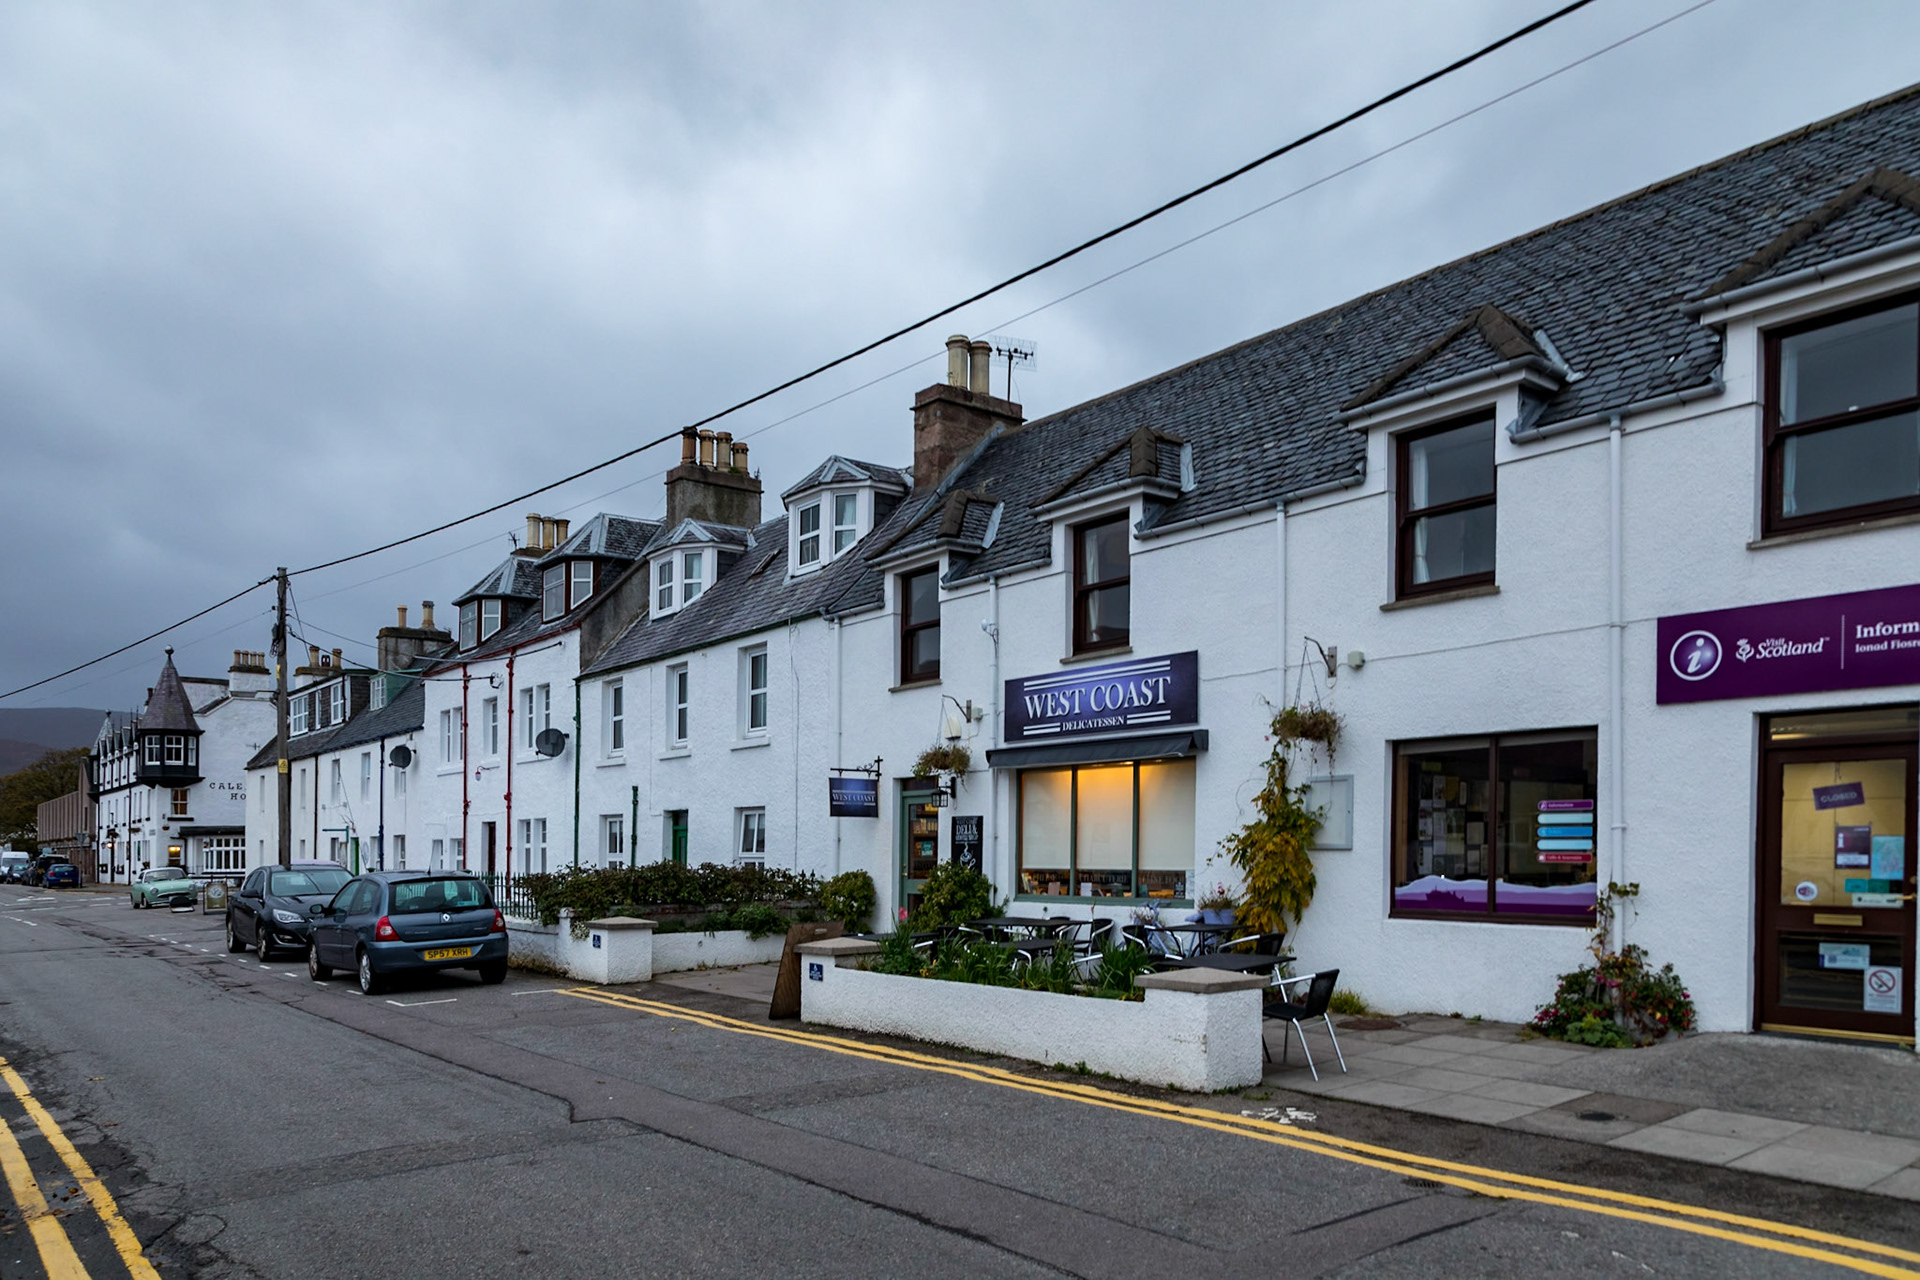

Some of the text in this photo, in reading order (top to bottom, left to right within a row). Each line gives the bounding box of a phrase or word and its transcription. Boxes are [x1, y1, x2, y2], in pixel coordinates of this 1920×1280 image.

[1856, 621, 1920, 639] Inform
[1756, 637, 1824, 659] Scotland
[1766, 637, 1785, 647] Visit
[1855, 640, 1888, 653] Ionad
[1024, 676, 1171, 720] WEST COAST
[1062, 715, 1125, 731] DELICATESSEN
[832, 793, 851, 802] WEST
[852, 794, 876, 803] COAST
[1820, 791, 1858, 803] CLOSED
[428, 947, 469, 959] SP57 XRH
